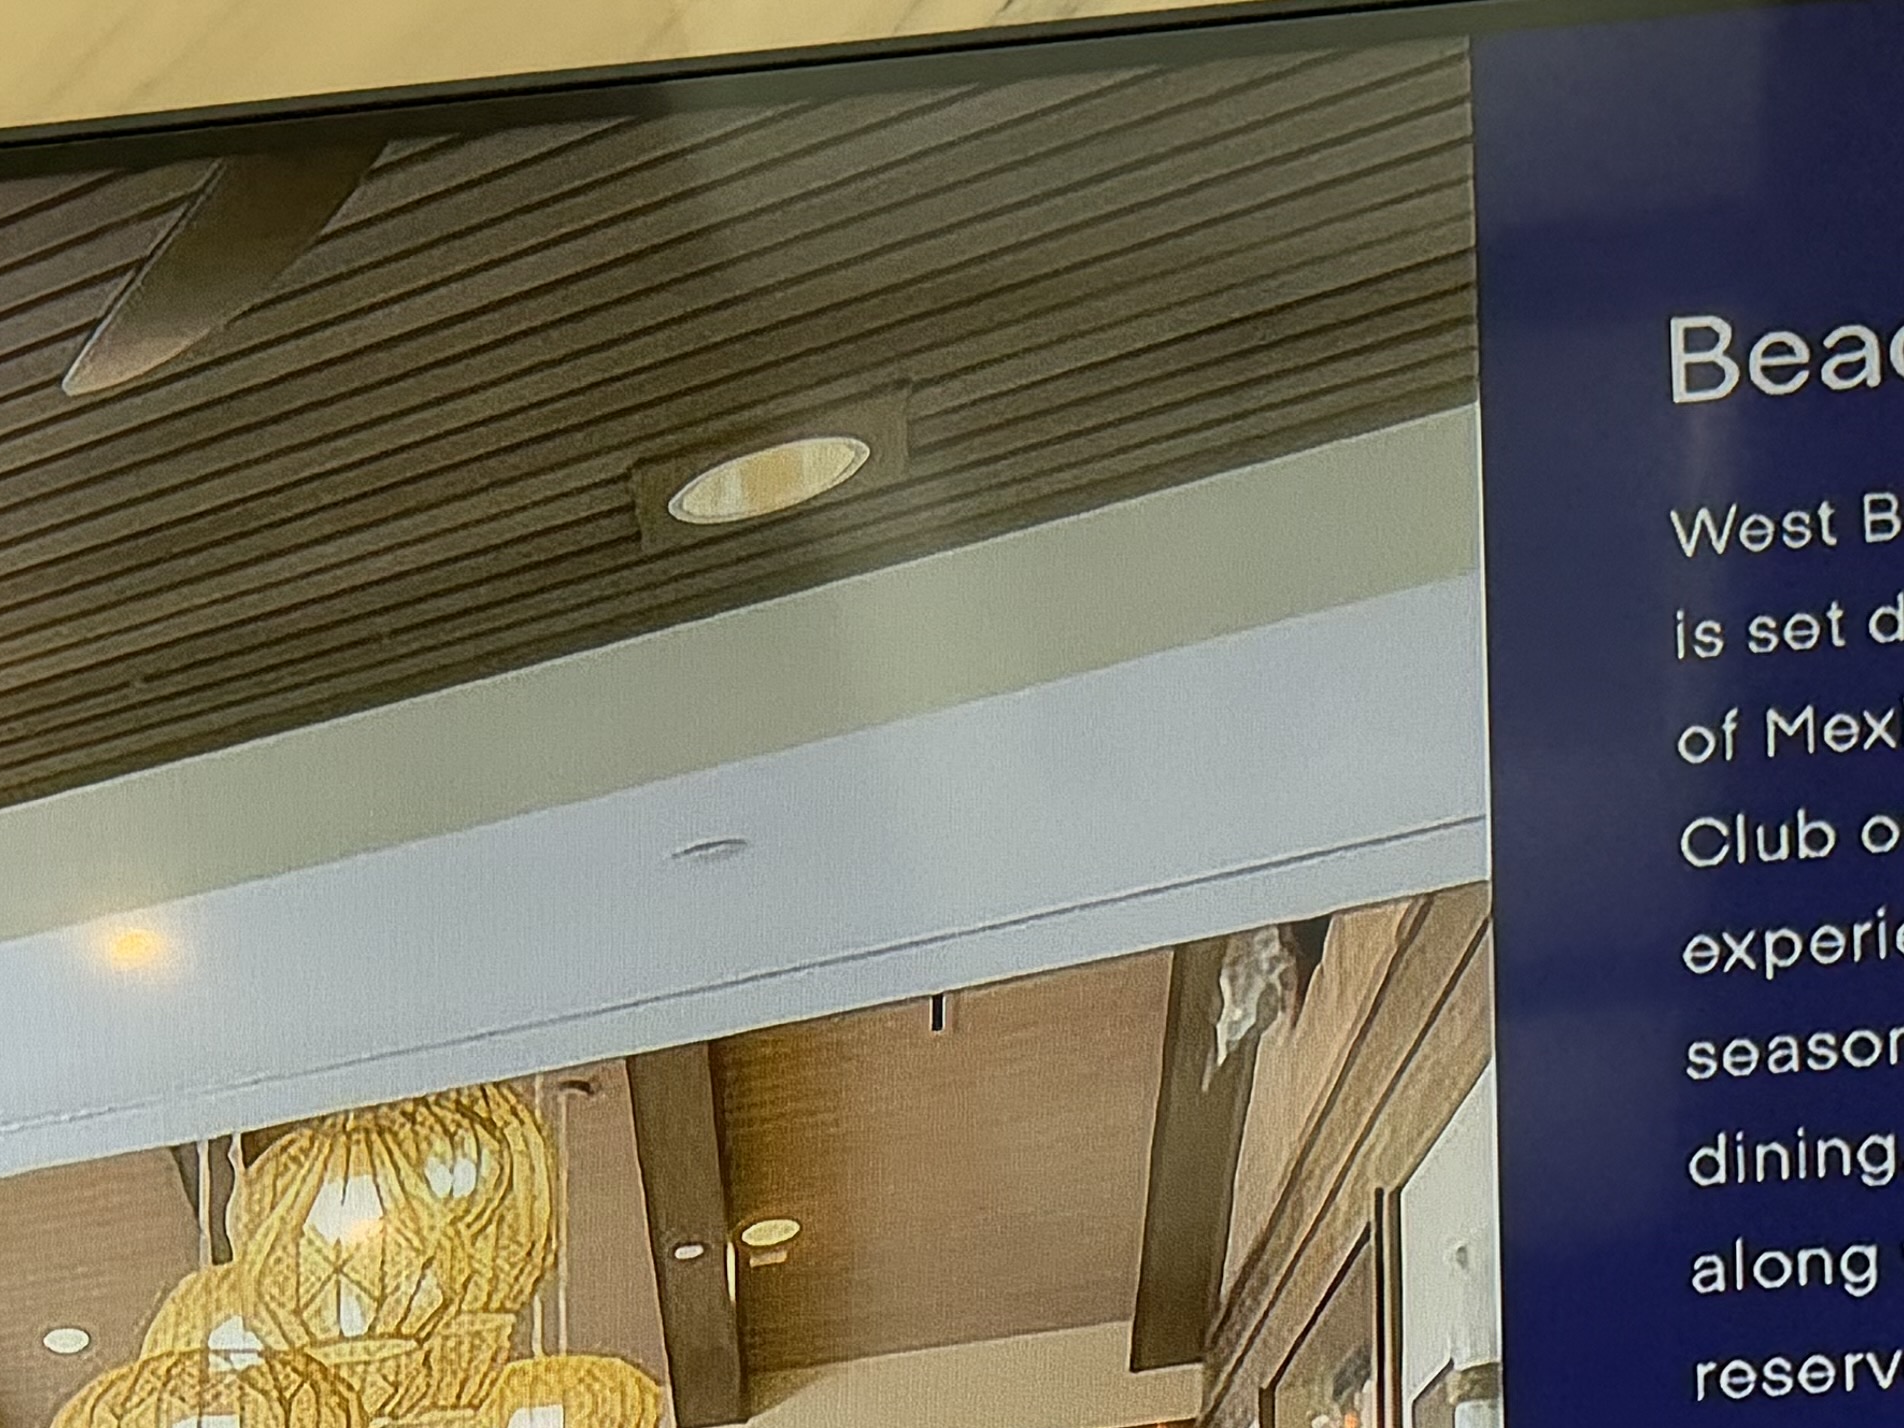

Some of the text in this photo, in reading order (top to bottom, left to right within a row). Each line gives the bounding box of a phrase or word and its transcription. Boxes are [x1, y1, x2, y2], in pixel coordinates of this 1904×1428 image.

[1670, 501, 1837, 557] West
[1677, 610, 1723, 659] is
[1749, 601, 1845, 653] set
[1678, 707, 1738, 763] of
[1681, 809, 1835, 866] Club
[1692, 1237, 1877, 1297] along
